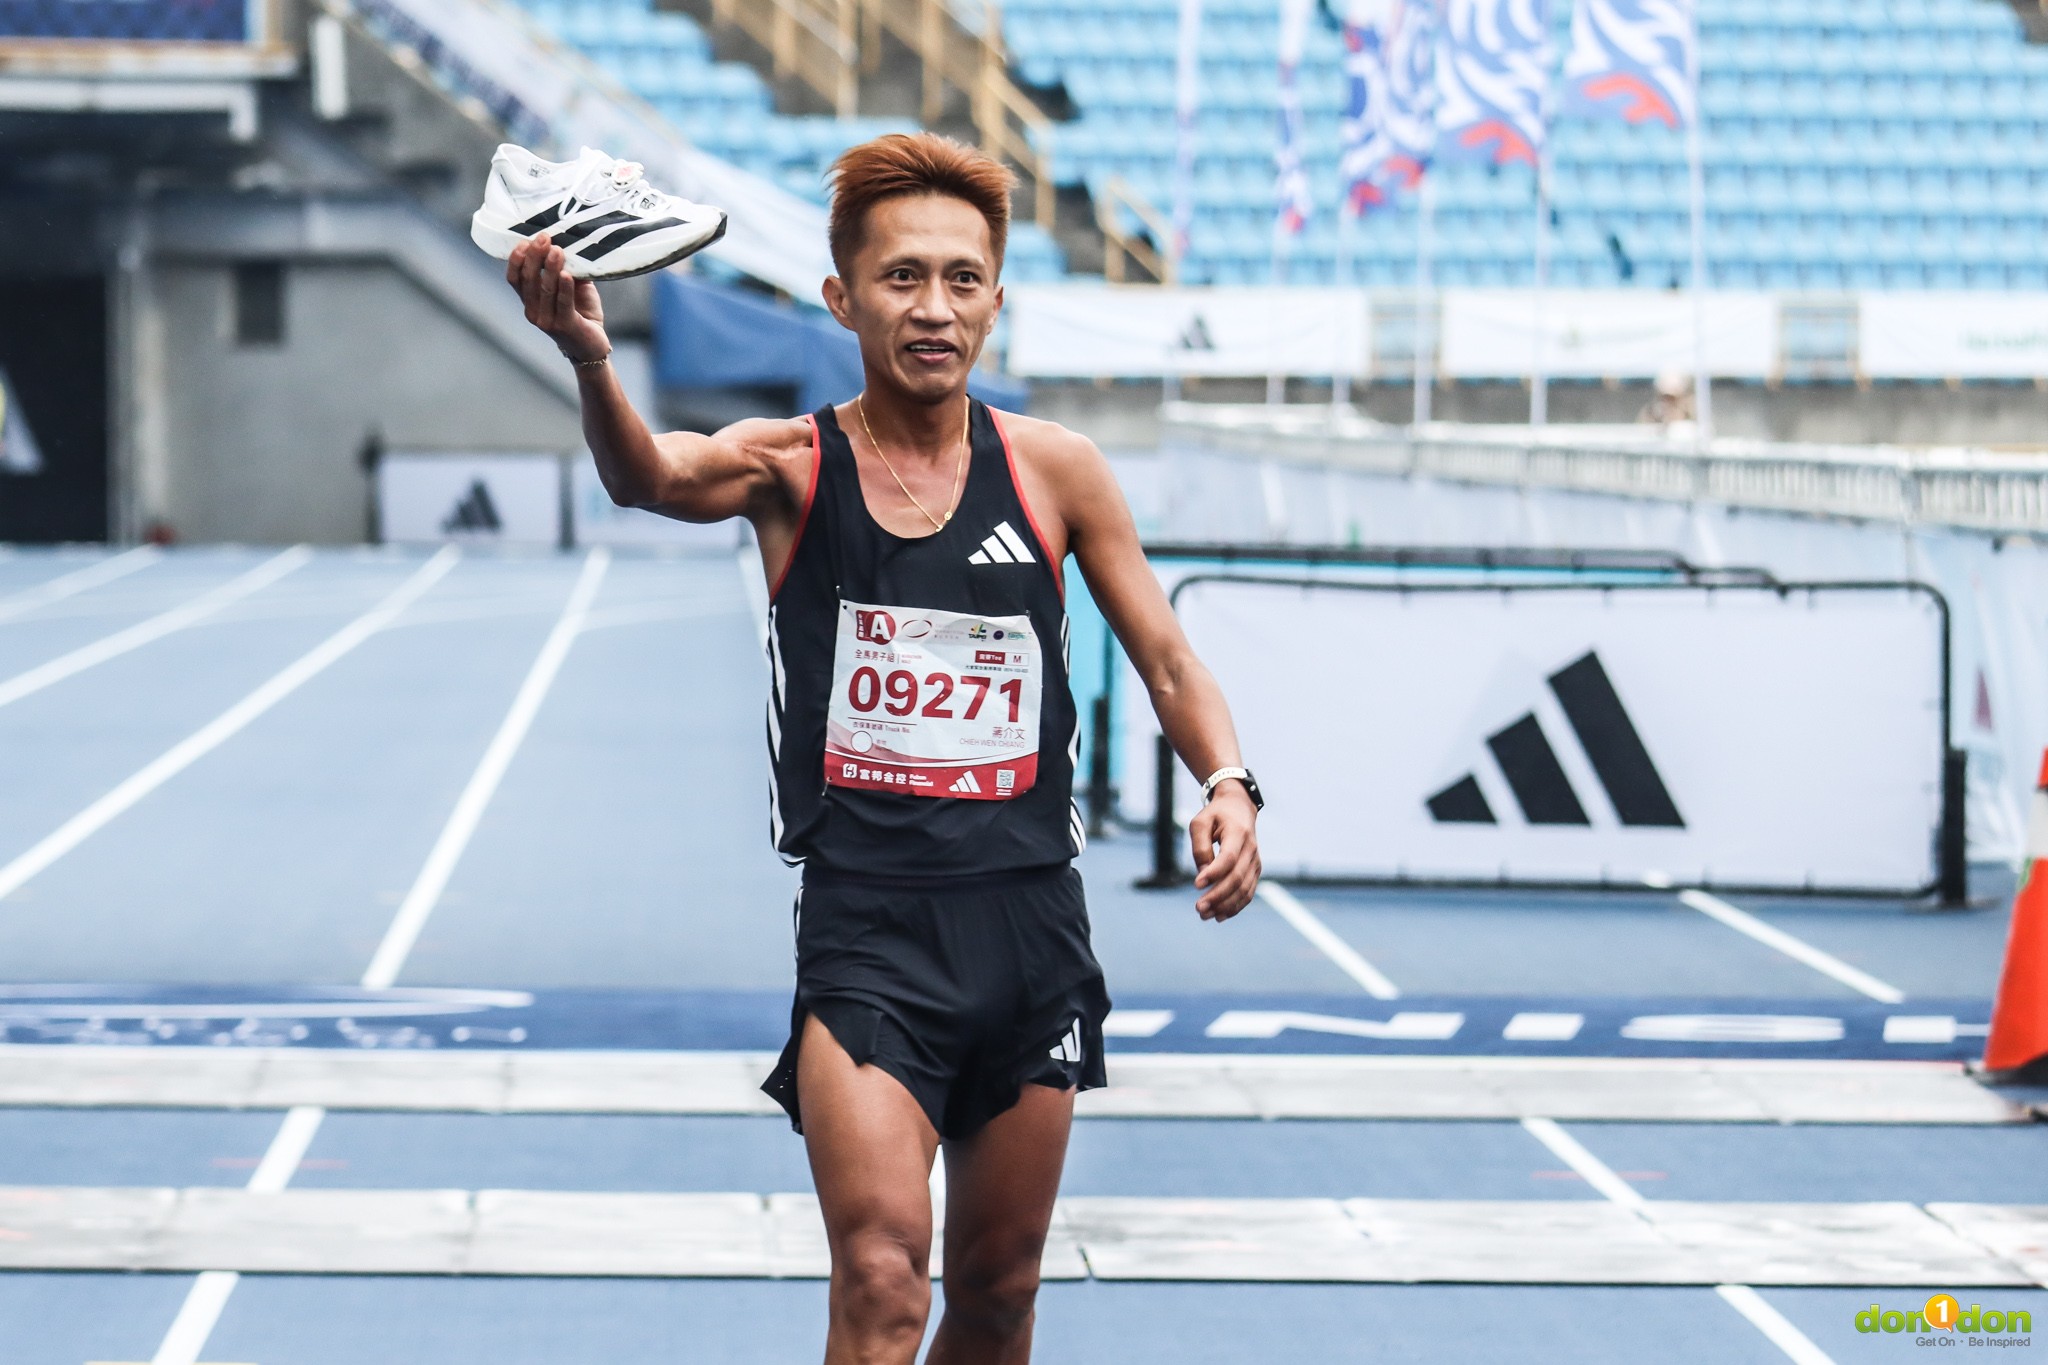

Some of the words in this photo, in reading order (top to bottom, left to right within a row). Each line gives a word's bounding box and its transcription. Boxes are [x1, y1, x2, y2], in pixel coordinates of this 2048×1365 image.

[870, 614, 892, 641] A
[855, 649, 895, 663] 全馬男子組
[1013, 655, 1022, 664] M
[848, 666, 1022, 723] 09271
[959, 738, 982, 746] CHIEH
[982, 739, 997, 747] WEN
[998, 740, 1025, 748] CHIANG
[859, 769, 907, 785] 富邦金控
